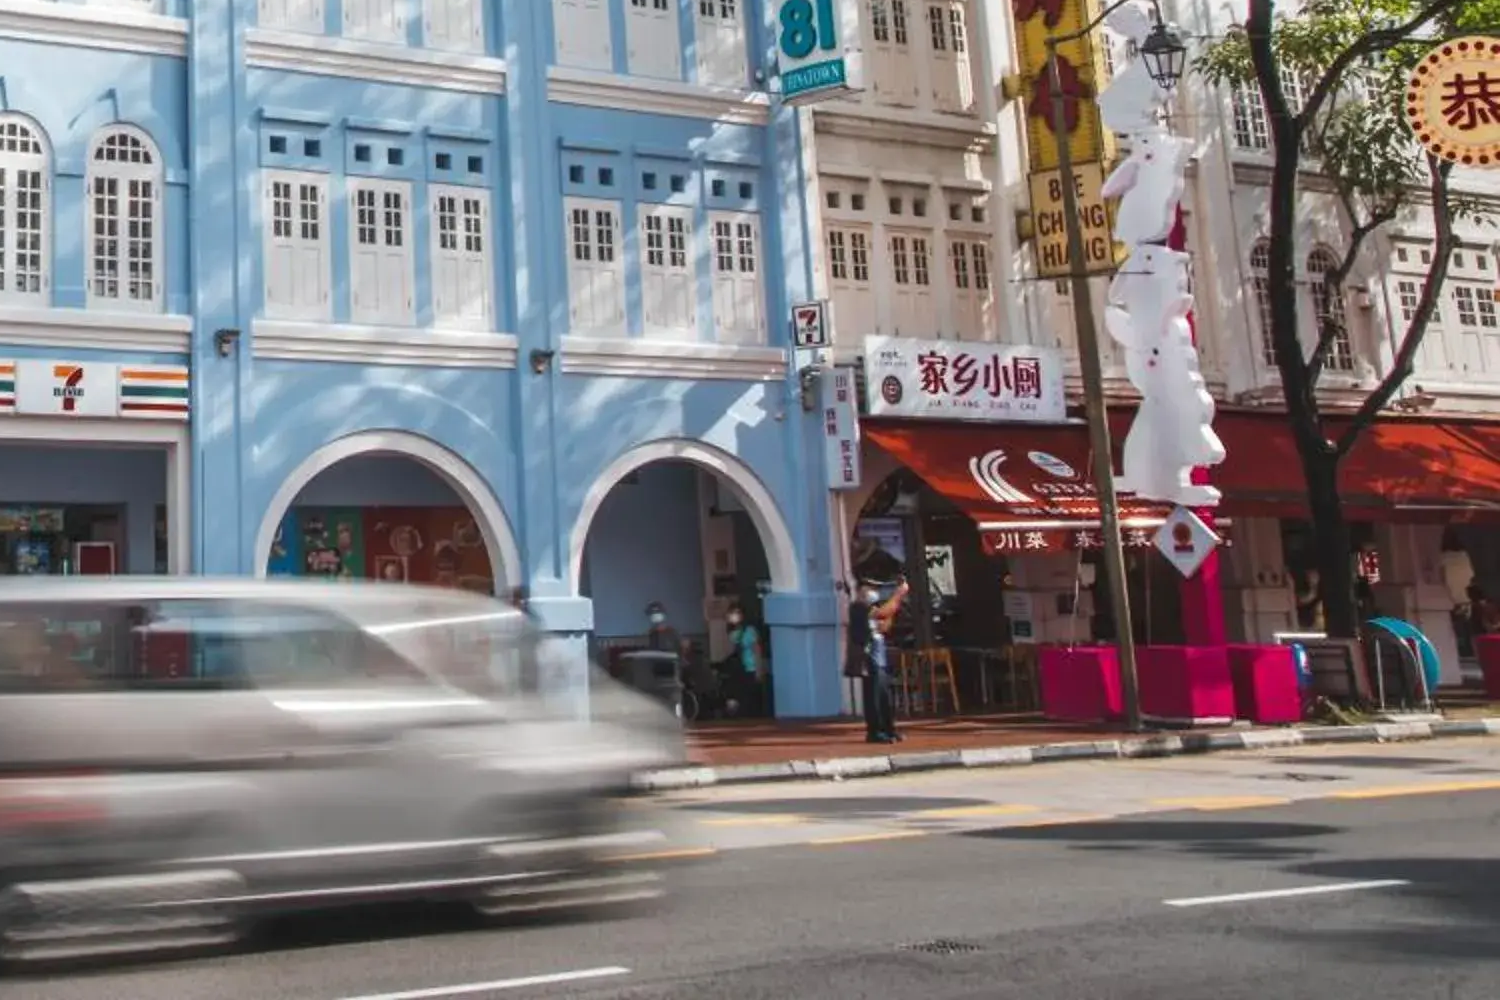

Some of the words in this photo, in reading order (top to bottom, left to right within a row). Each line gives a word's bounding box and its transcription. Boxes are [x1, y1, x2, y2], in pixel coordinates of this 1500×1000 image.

[1440, 71, 1500, 131] 恭
[1037, 204, 1105, 235] CHNG
[53, 364, 84, 411] 7
